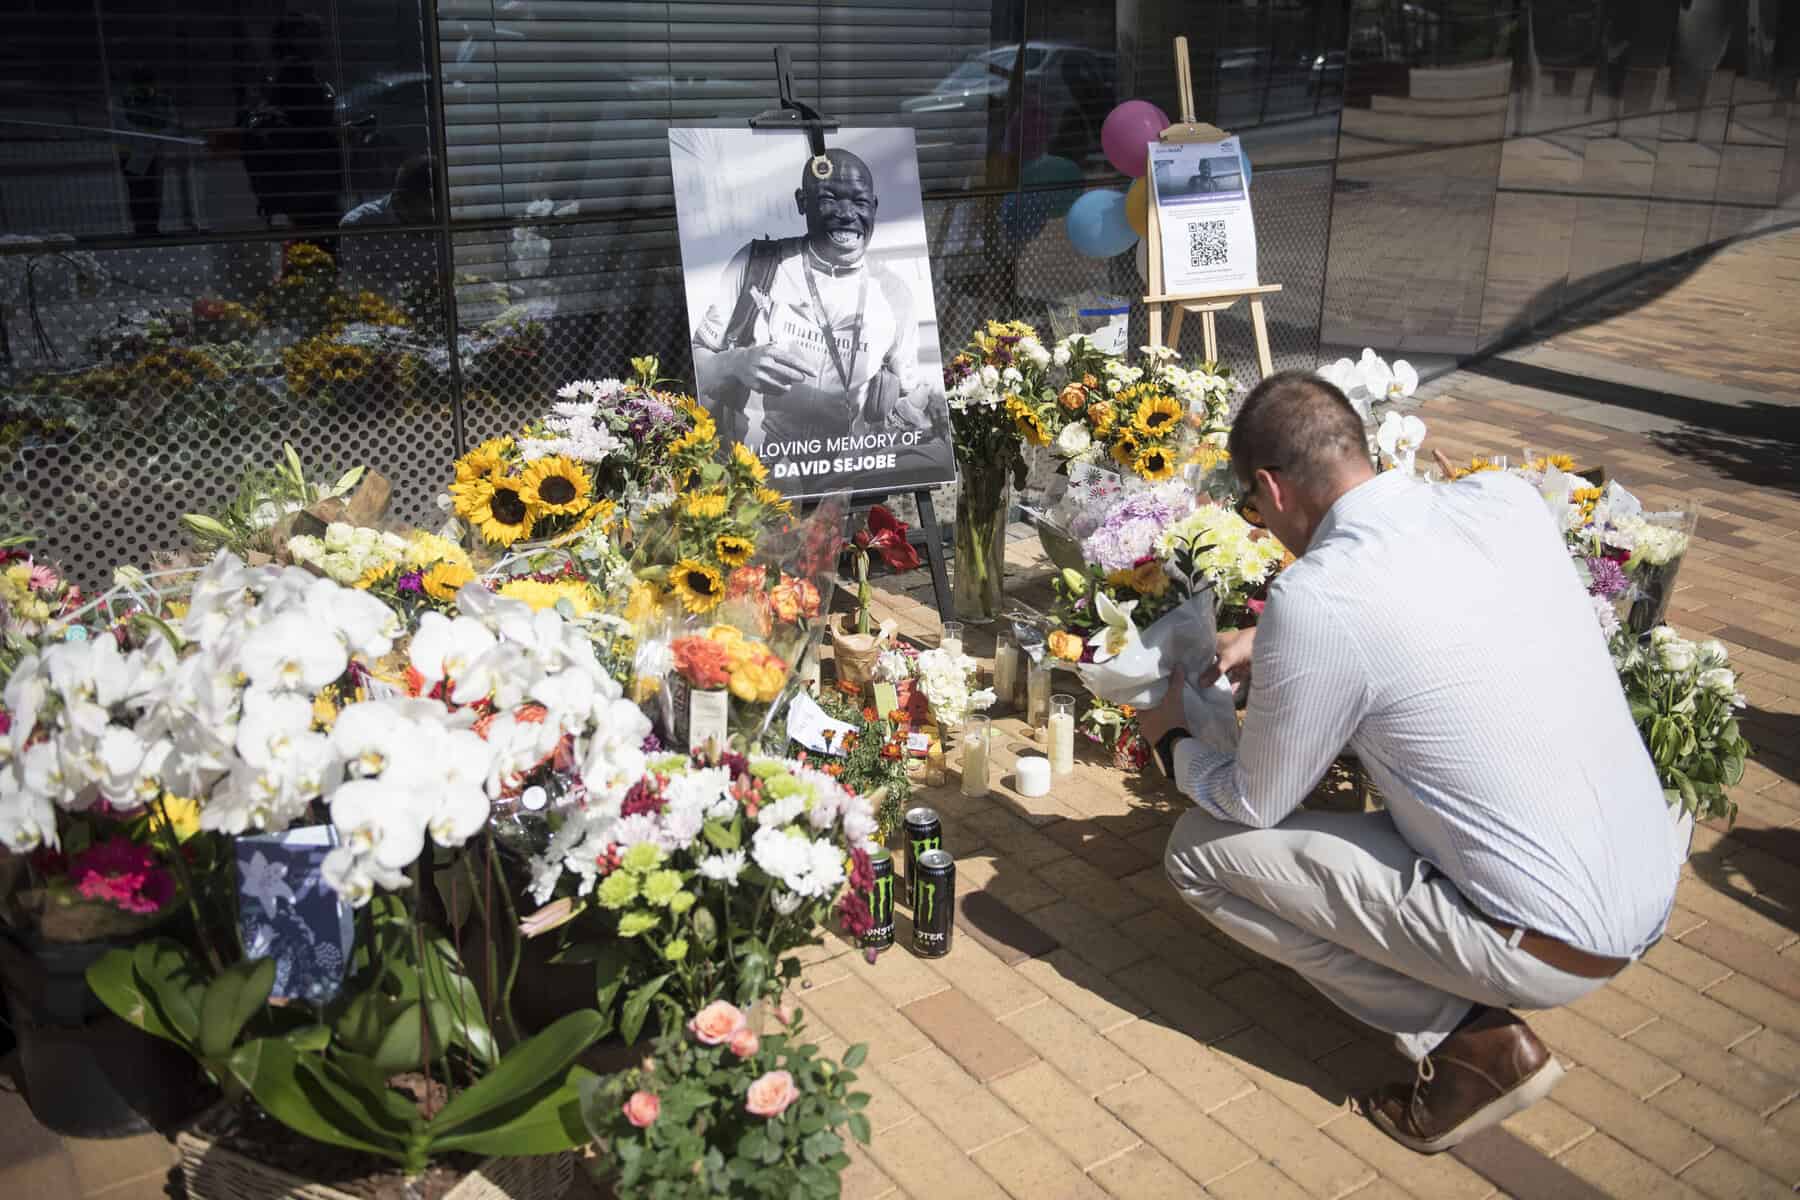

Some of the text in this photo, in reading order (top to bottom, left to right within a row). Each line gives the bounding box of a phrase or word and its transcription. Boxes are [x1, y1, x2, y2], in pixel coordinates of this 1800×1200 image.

[759, 439, 821, 458] LOVING
[827, 433, 897, 453] MEMORY
[902, 431, 923, 446] OF
[774, 454, 897, 478] DAVID SEJOBE
